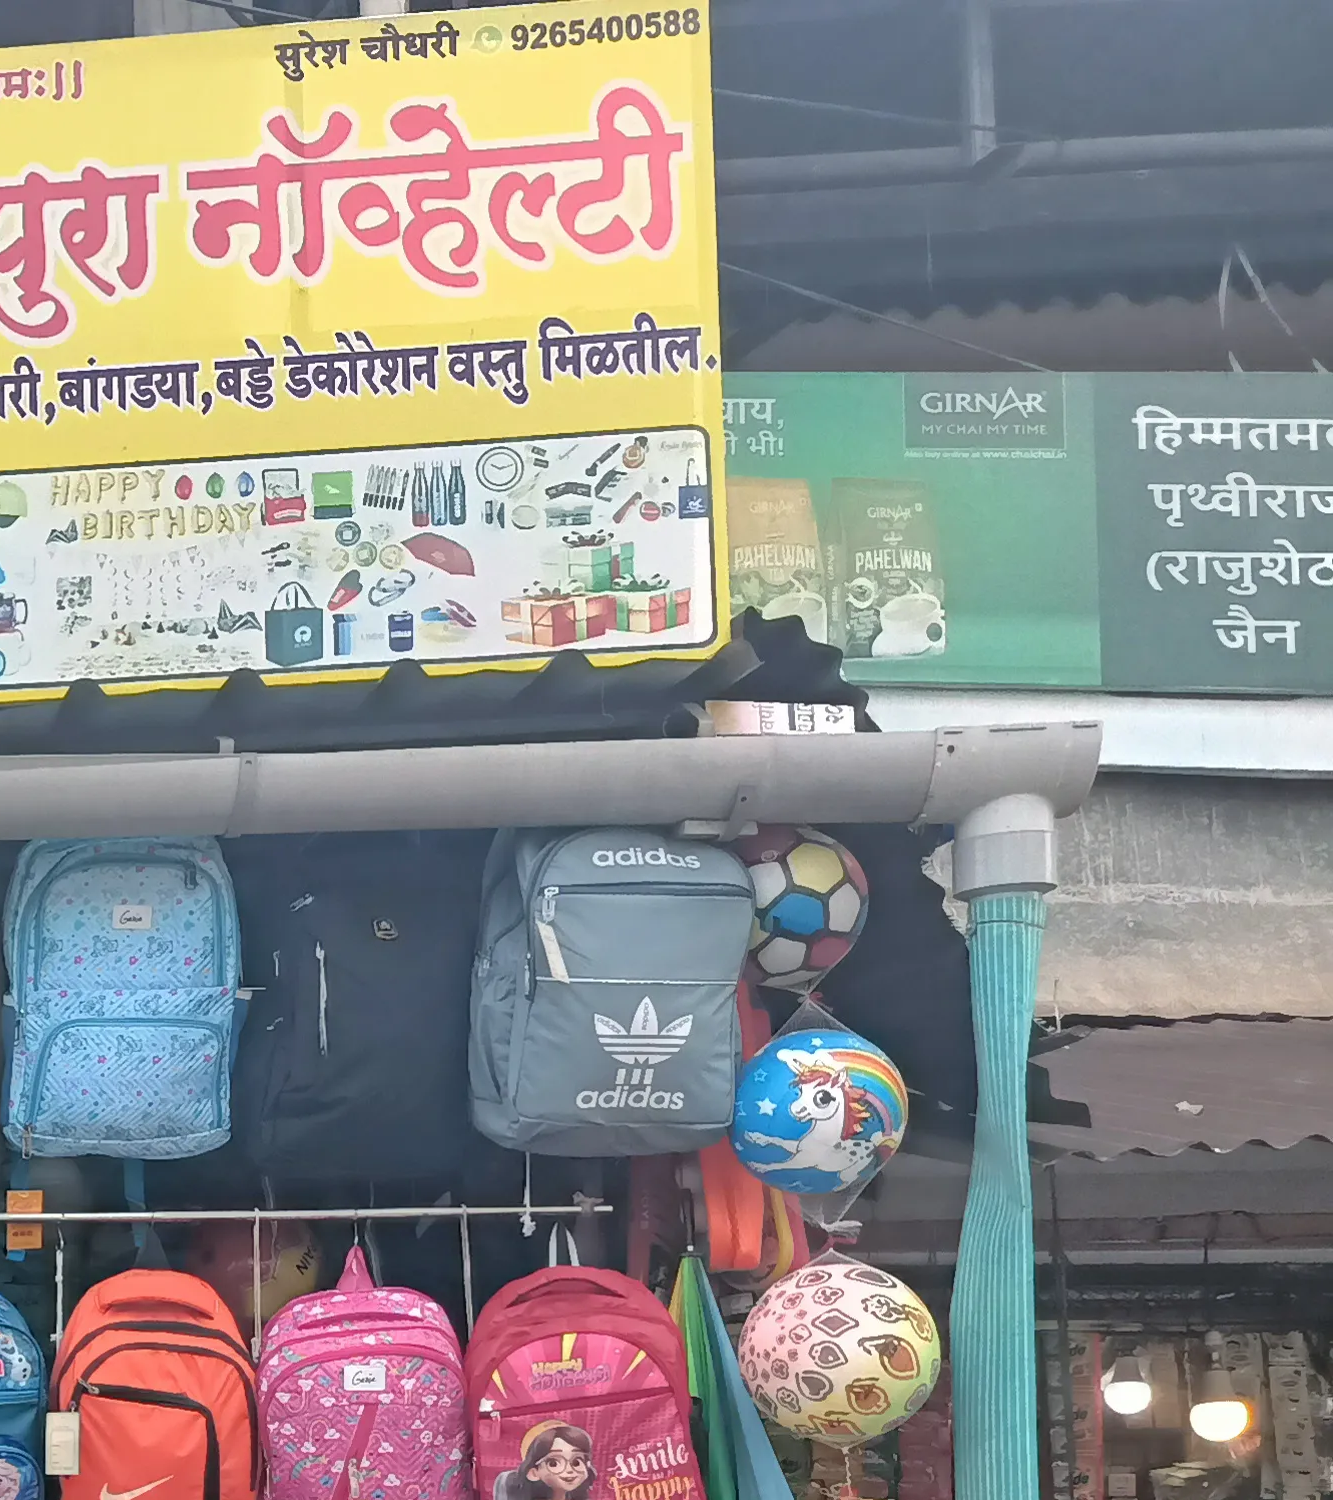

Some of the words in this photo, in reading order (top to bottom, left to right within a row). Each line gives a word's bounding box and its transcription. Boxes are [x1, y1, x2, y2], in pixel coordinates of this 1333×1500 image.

[275, 39, 350, 82] सुरेश
[361, 24, 460, 65] चौधरी
[511, 9, 701, 51] 9265400588
[187, 87, 683, 288] नॉव्हेल्टी
[283, 332, 438, 399] डेकोरेशन
[448, 340, 528, 404] वस्तु
[539, 314, 718, 381] मिळतील.
[920, 386, 1047, 420] GIRNAR
[921, 424, 942, 435] MY
[946, 424, 982, 435] CHAI
[986, 424, 1009, 435] MY
[1013, 424, 1049, 435] TIME
[49, 468, 165, 505] HAPPY
[82, 501, 256, 541] BIRTHDAY
[866, 504, 913, 522] GIRNAR
[733, 543, 816, 570] PAHELWAN
[855, 549, 933, 574] PAHELWAN
[1212, 603, 1302, 654] जैन
[592, 847, 701, 869] adidas
[575, 1086, 686, 1111] adidas
